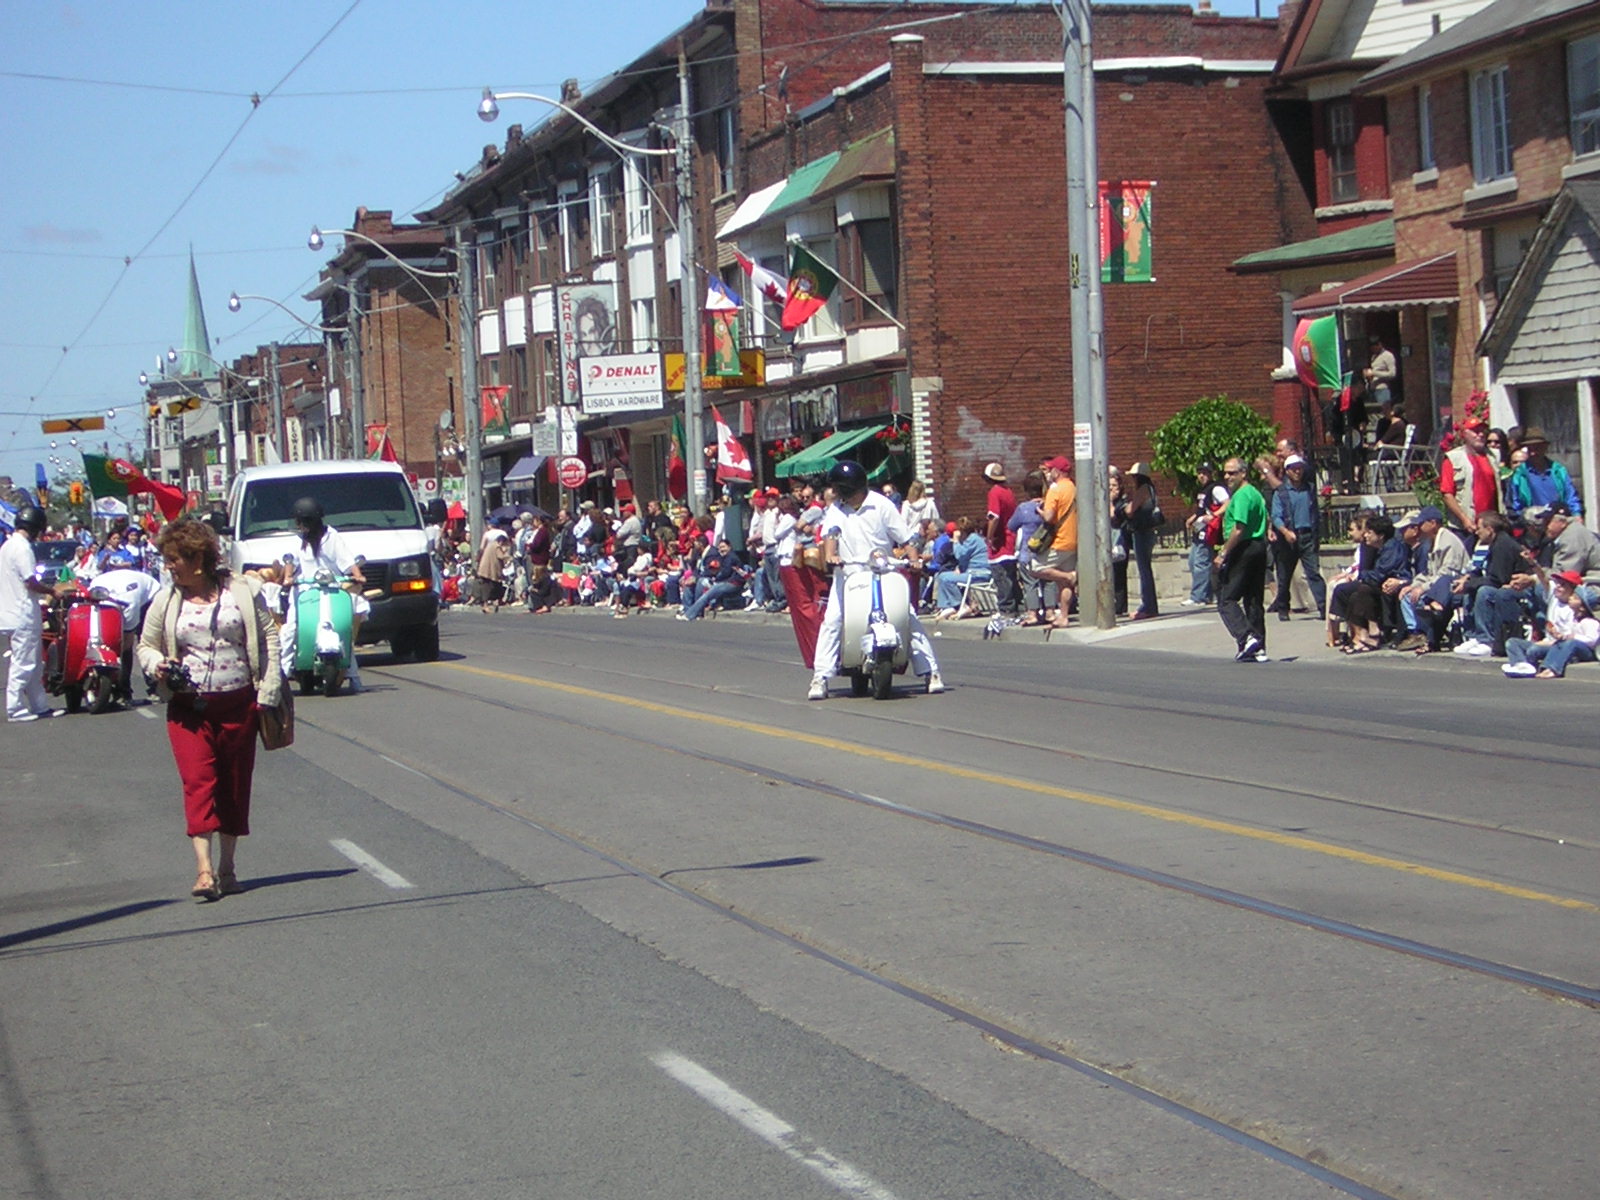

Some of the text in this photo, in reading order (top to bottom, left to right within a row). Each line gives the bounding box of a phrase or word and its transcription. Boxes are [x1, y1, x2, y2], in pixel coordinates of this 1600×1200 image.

[561, 292, 577, 392] CHRISTINAS
[606, 364, 658, 378] DENALT
[586, 395, 660, 409] LISBOA HARDWARE
